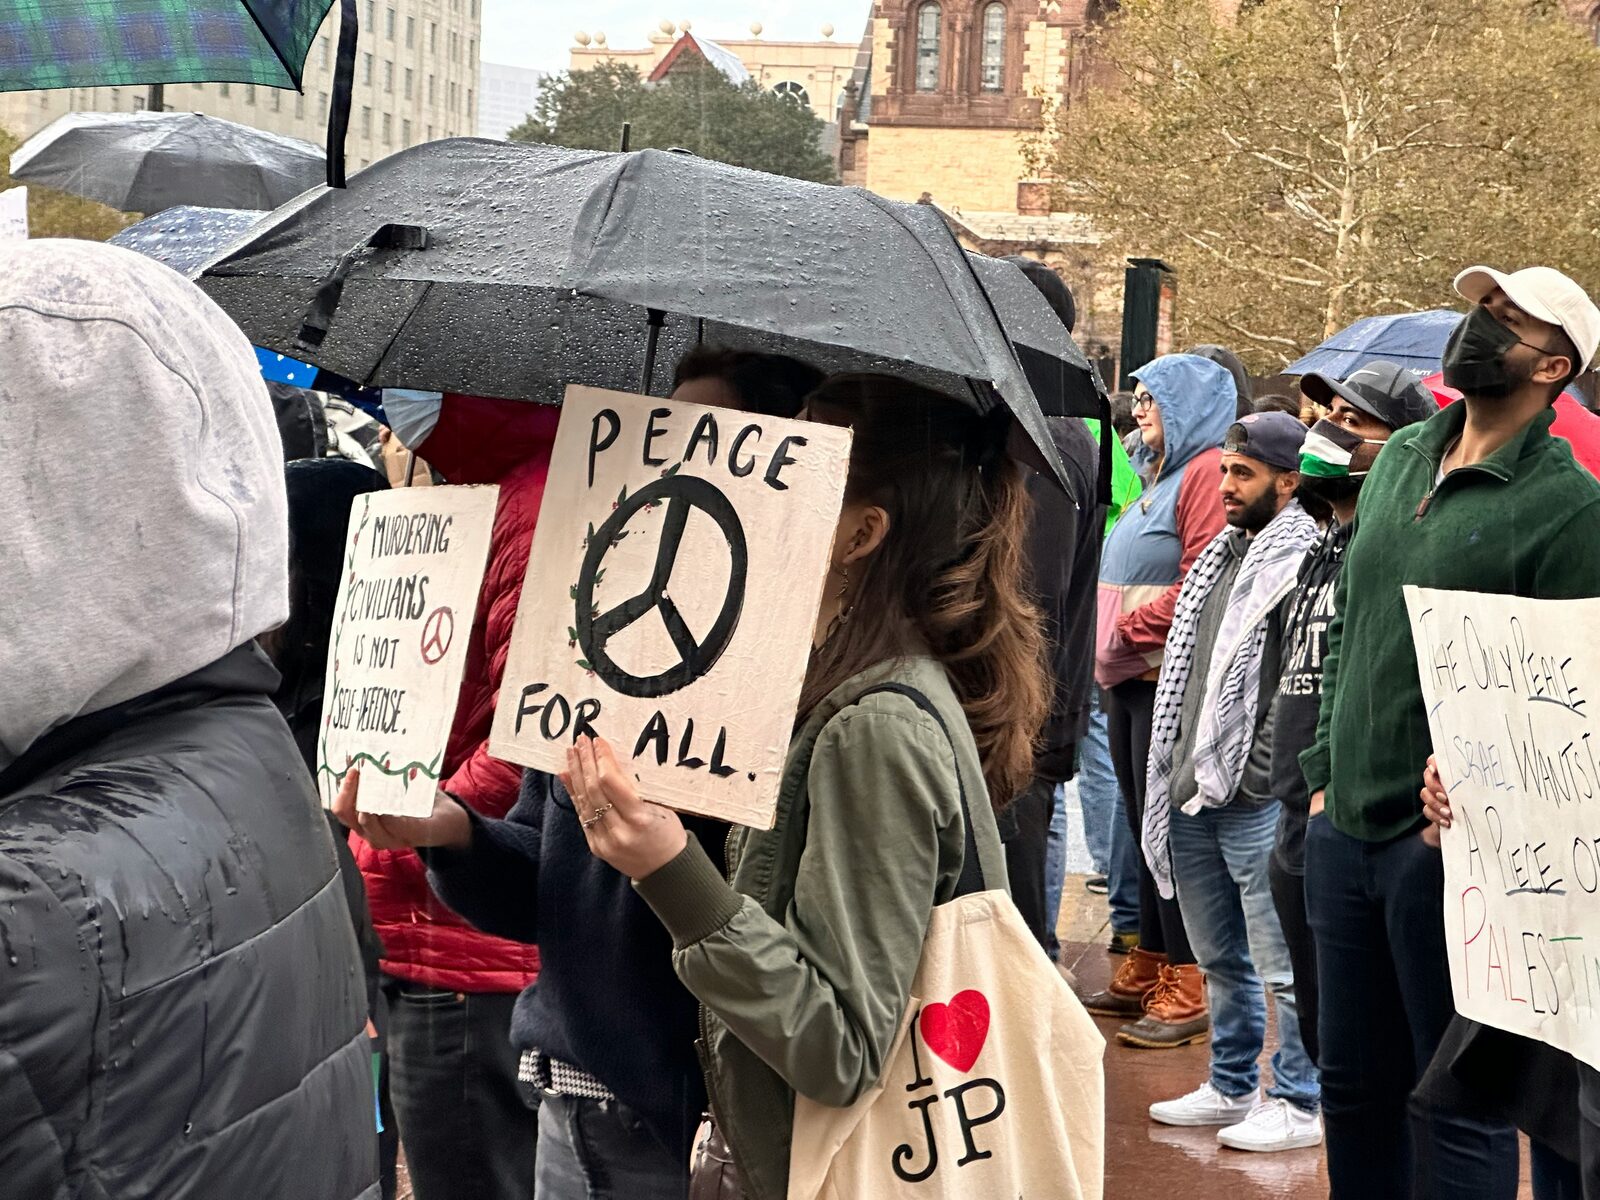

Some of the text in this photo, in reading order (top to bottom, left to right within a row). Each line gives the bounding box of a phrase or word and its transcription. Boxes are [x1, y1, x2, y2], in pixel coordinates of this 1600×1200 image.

[588, 408, 808, 490] PEACE
[371, 514, 453, 559] MURDERING
[350, 575, 430, 621] CIVILIANS
[353, 634, 400, 670] IS NOT
[1419, 608, 1586, 709] THE ONLY PEACE
[515, 682, 758, 782] FOR ALL.
[1430, 700, 1515, 794] ISRAEL
[1504, 712, 1593, 809] WANTS
[1461, 805, 1487, 885] A
[1485, 806, 1564, 895] PIECE
[906, 1009, 933, 1092] I
[891, 1077, 1006, 1183] JP
